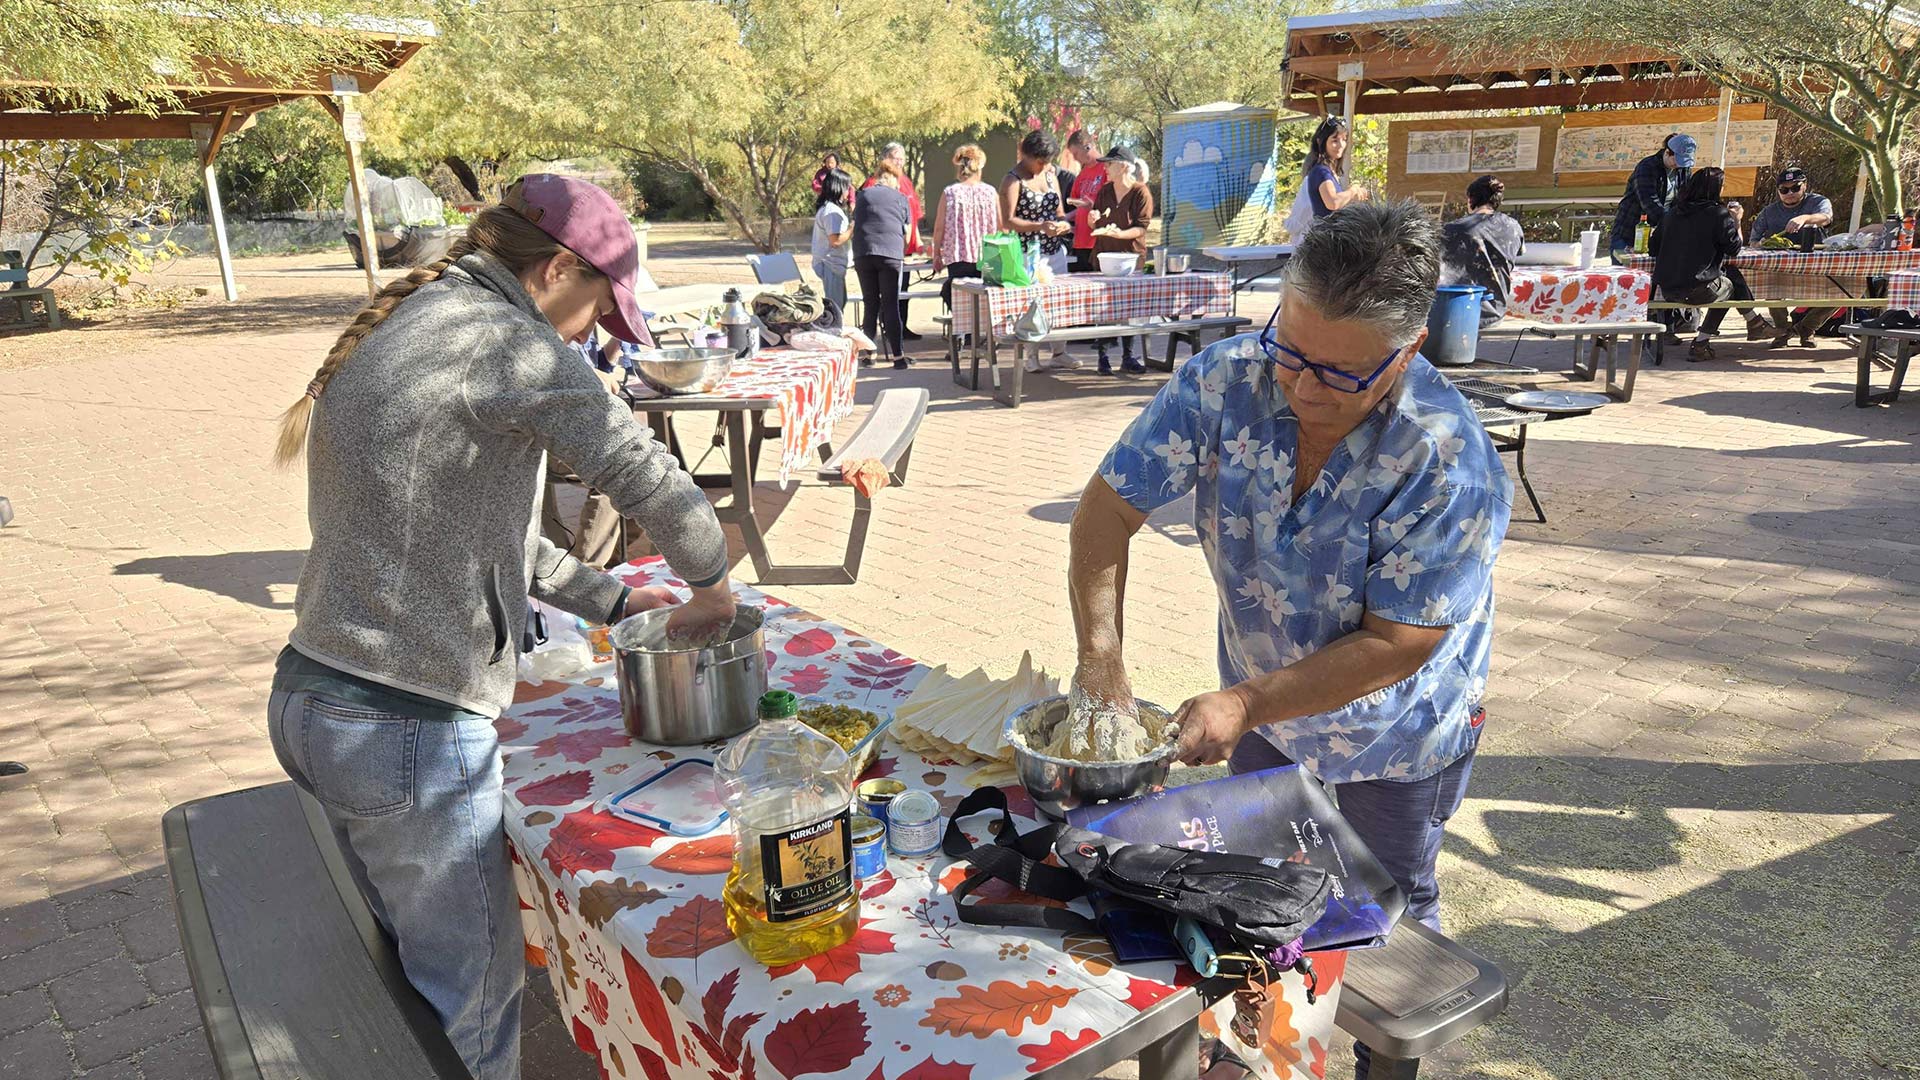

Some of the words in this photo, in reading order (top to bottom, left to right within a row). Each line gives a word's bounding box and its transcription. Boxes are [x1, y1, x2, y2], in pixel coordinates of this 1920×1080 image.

[790, 820, 833, 840] KIRKLAND
[1206, 816, 1225, 847] PLACE
[1289, 821, 1300, 834] DAY
[1296, 835, 1308, 853] NEXT
[791, 884, 824, 899] OLIVE
[825, 876, 841, 888] OIL
